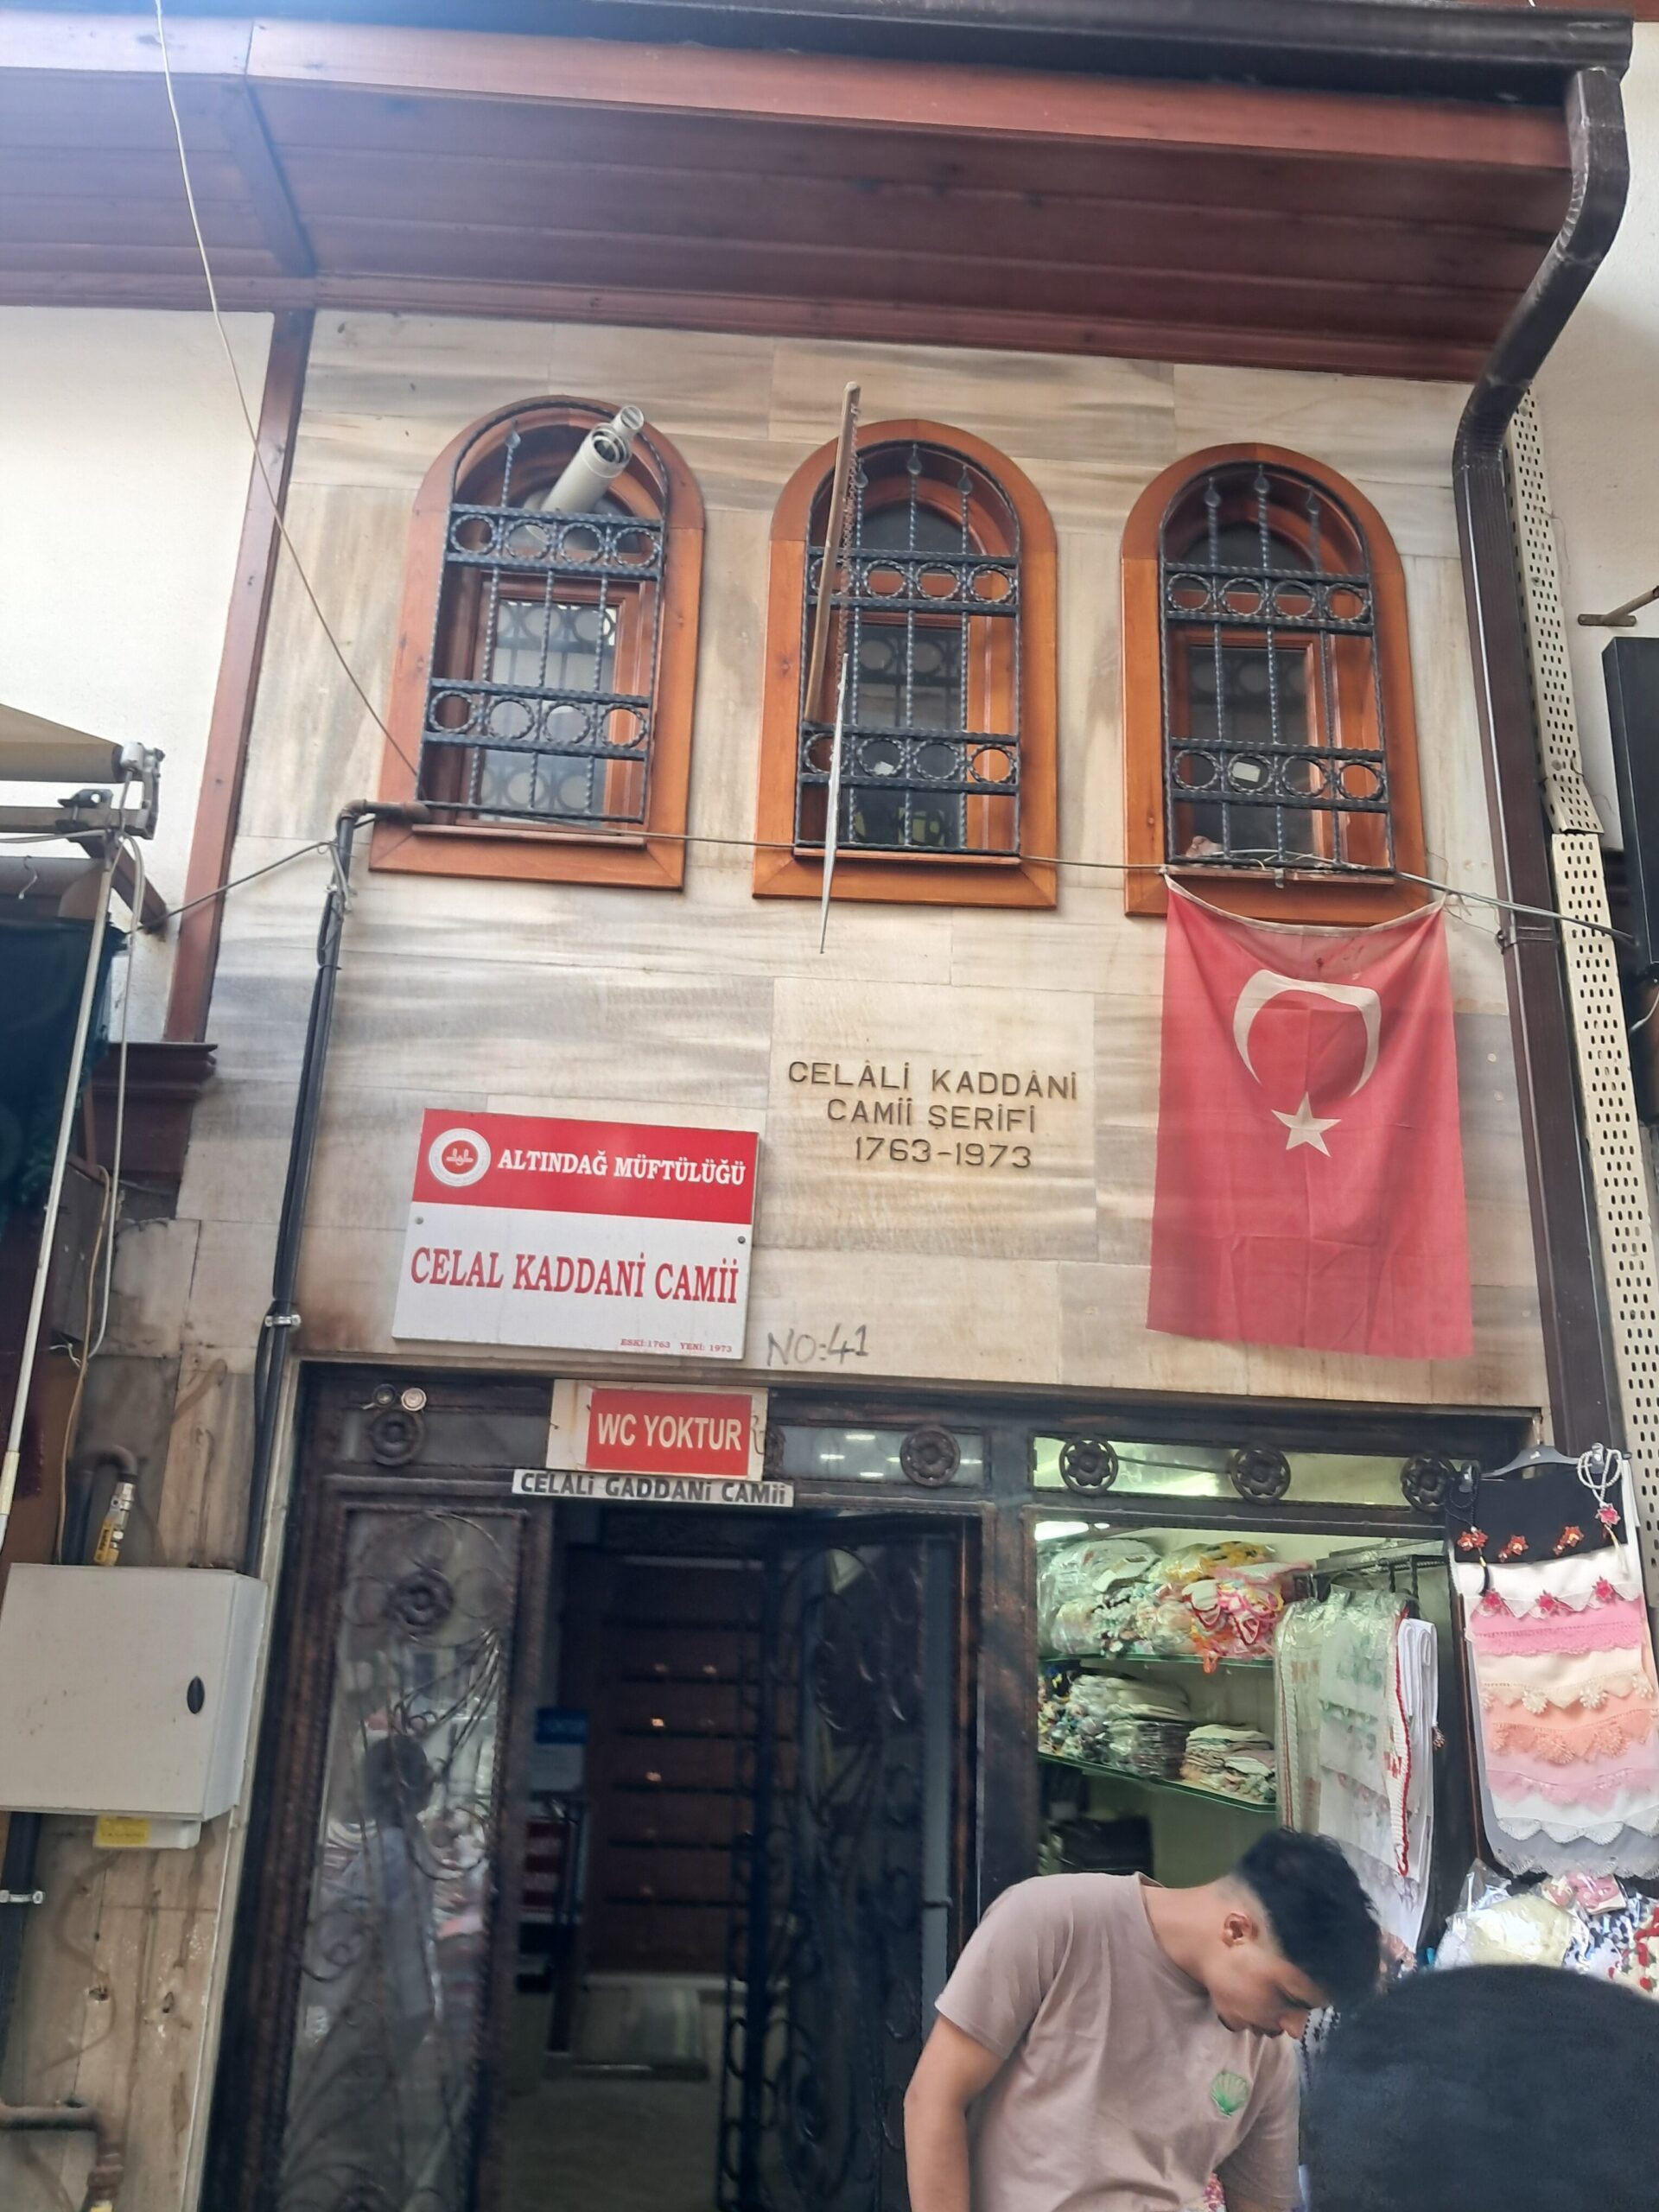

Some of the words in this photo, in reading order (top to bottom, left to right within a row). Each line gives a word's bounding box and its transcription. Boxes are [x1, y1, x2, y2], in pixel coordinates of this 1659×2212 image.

[827, 1097, 912, 1127] CAMİİ
[928, 1103, 1036, 1133] ŞERİFİ
[498, 1148, 607, 1176] ALTINDAĞ
[613, 1154, 746, 1185] MÜFTÜLÜĞÜ
[855, 1135, 1032, 1168] 1763-1973
[411, 1247, 504, 1288] CELAL
[512, 1252, 645, 1297] KADDANİ
[655, 1258, 739, 1304] CAMİİ
[766, 1323, 869, 1367] NO:41
[598, 1413, 636, 1446] WC
[644, 1414, 742, 1451] YOKTUR
